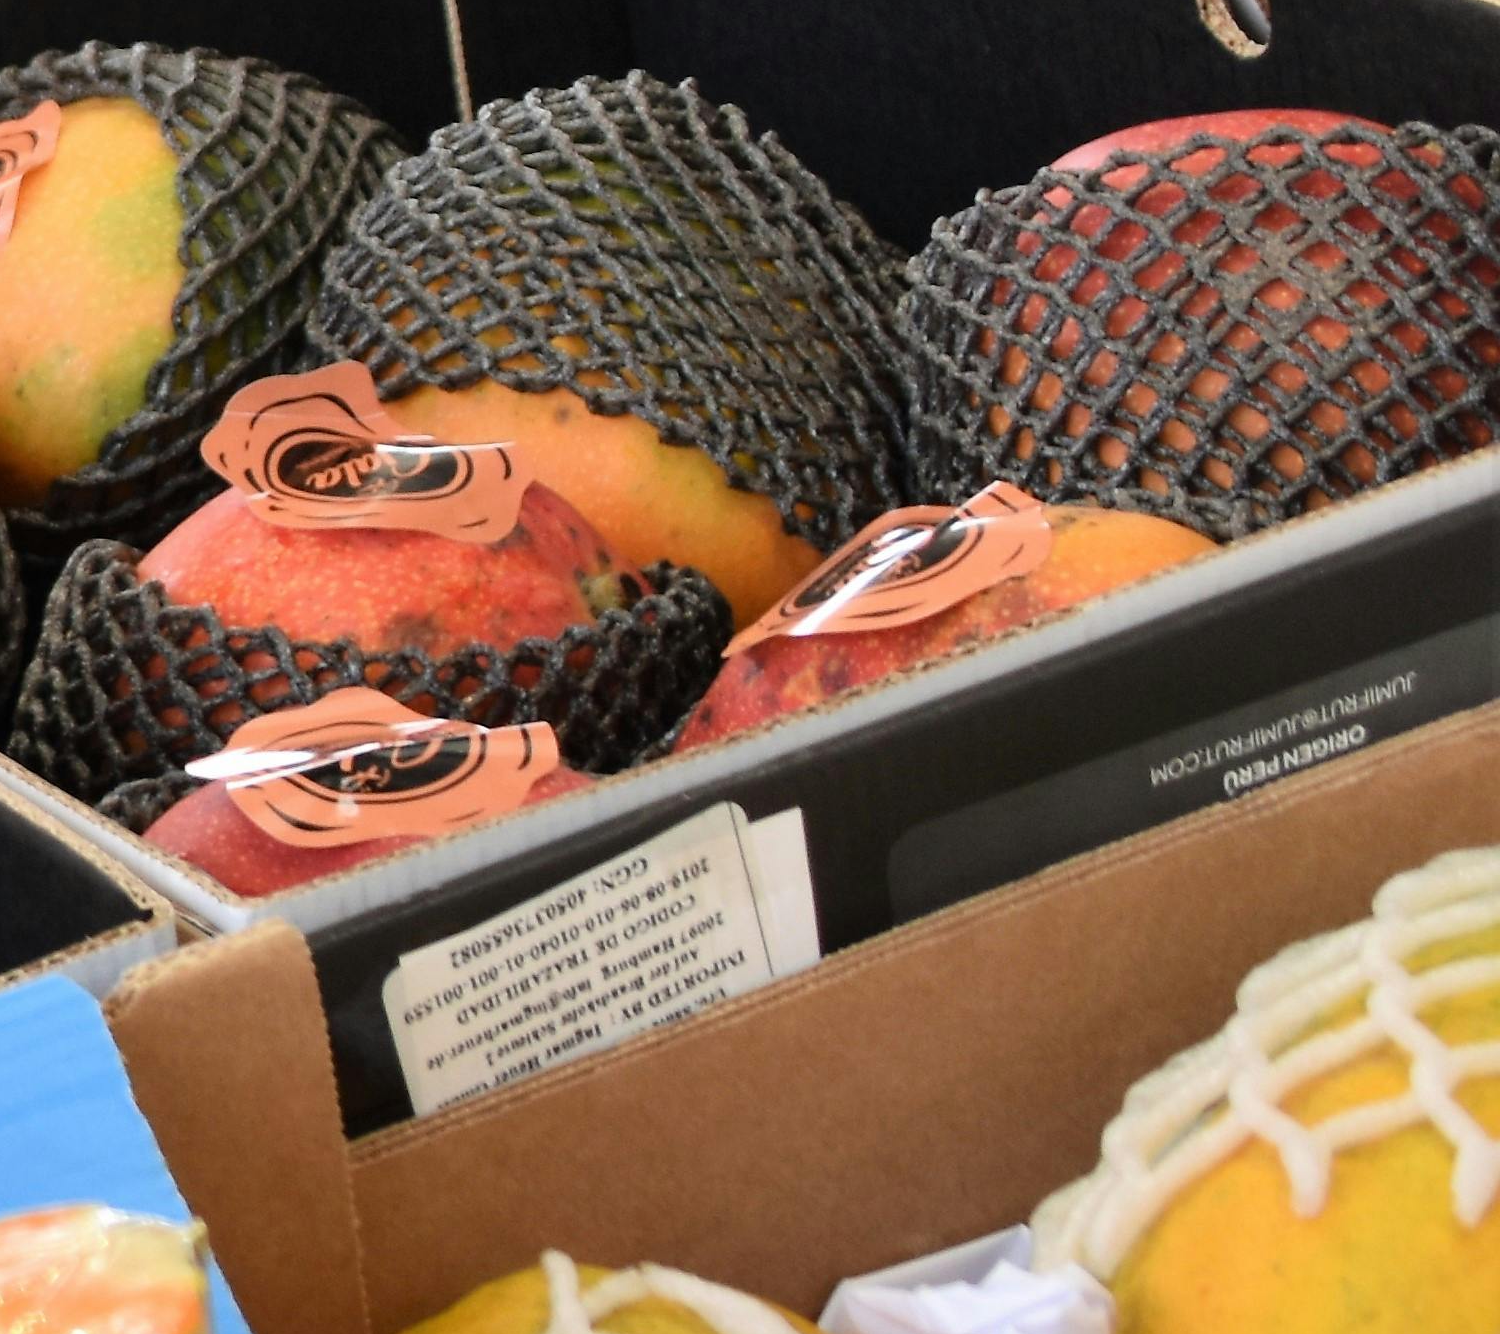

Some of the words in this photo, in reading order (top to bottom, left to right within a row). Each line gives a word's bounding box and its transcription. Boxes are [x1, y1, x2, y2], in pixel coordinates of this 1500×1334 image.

[1150, 670, 1418, 787] JUMIFRUT@JUMIFRUT.COM
[1283, 724, 1366, 770] ORIGEN
[1222, 754, 1280, 797] PERÚ
[592, 856, 649, 895] GGN:
[624, 895, 696, 940] CODIGO
[680, 911, 724, 944] 20097
[597, 933, 619, 956] DE
[601, 936, 676, 980] Hamburg
[456, 950, 589, 1026] TRAZABILIDAD
[644, 964, 668, 986] der
[648, 948, 746, 1009] IMPORTED
[621, 998, 644, 1022] BY
[545, 1023, 602, 1061] Ingmar
